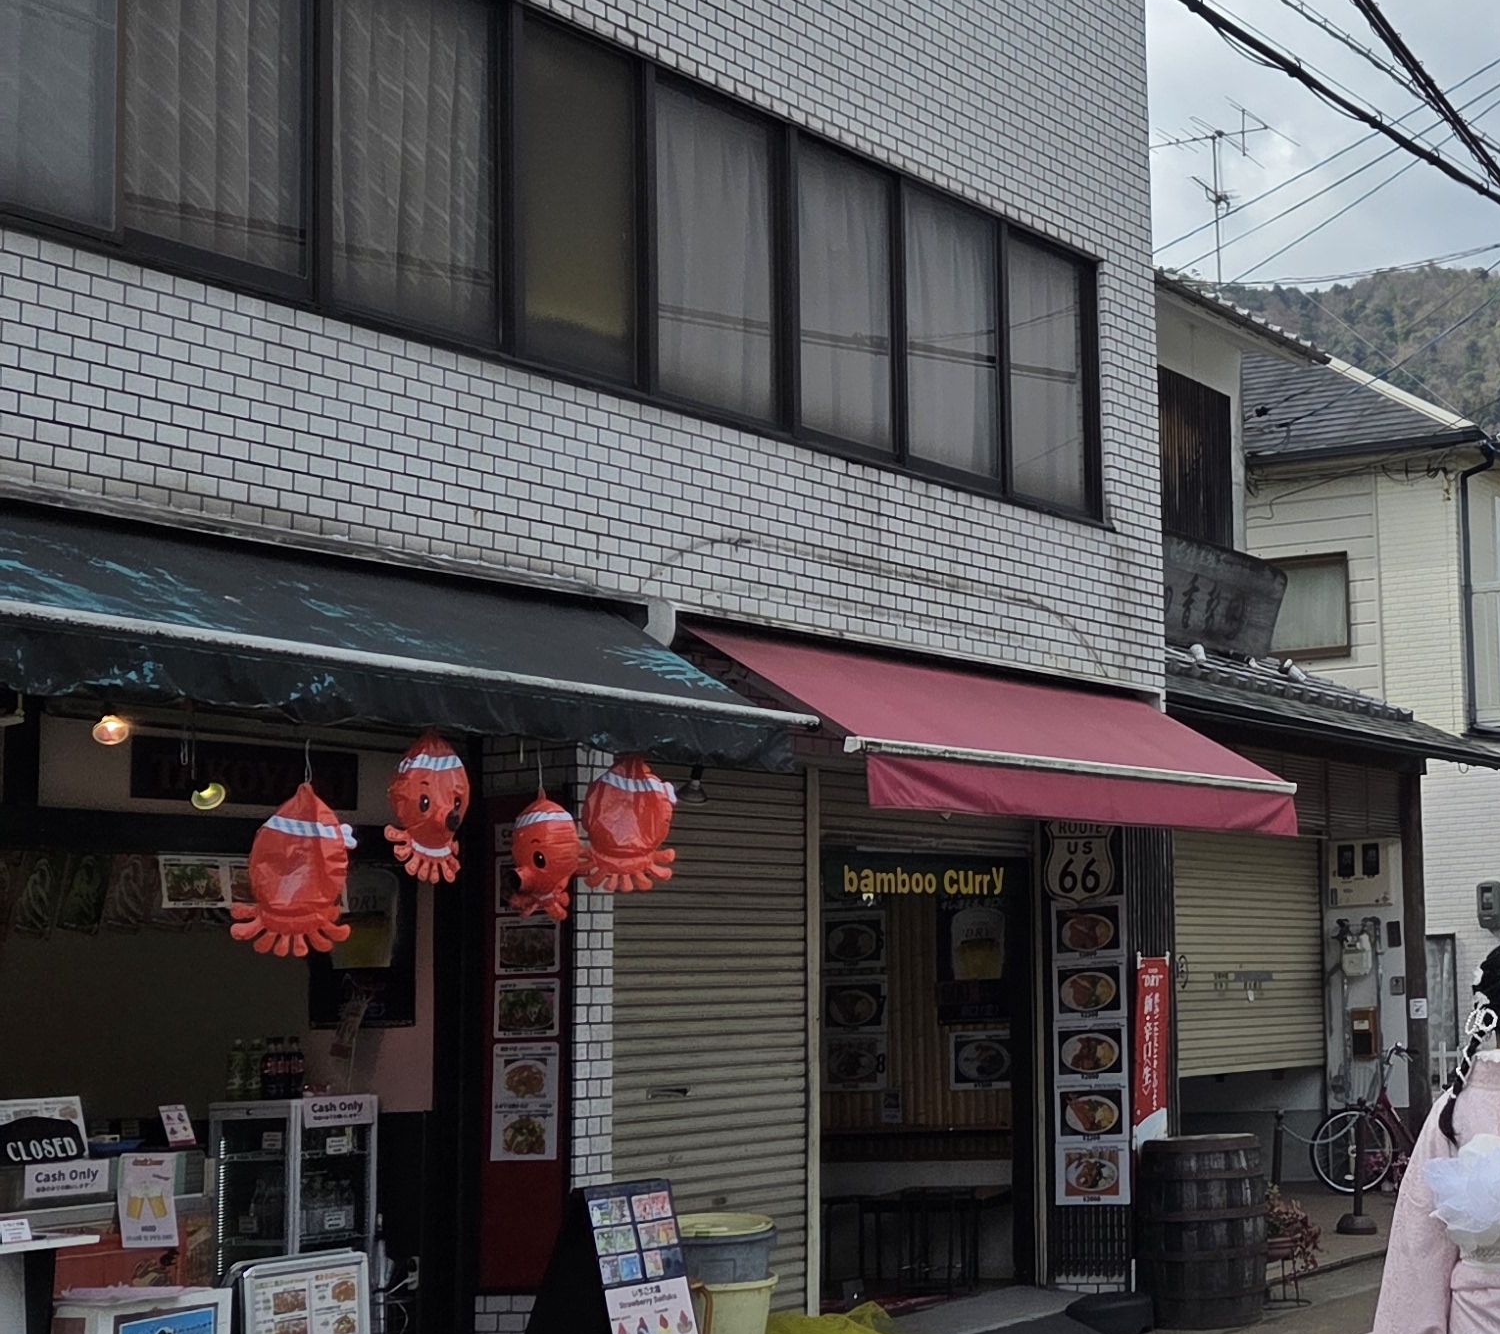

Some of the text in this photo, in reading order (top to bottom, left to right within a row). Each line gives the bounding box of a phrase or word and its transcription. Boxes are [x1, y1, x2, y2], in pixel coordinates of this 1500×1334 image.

[1059, 821, 1103, 835] ROUTE
[843, 864, 937, 894] bamboo
[1059, 857, 1101, 894] 66
[311, 1100, 364, 1114] Cash Only
[6, 1136, 78, 1162] CLOSED
[35, 1167, 99, 1184] Cash Only
